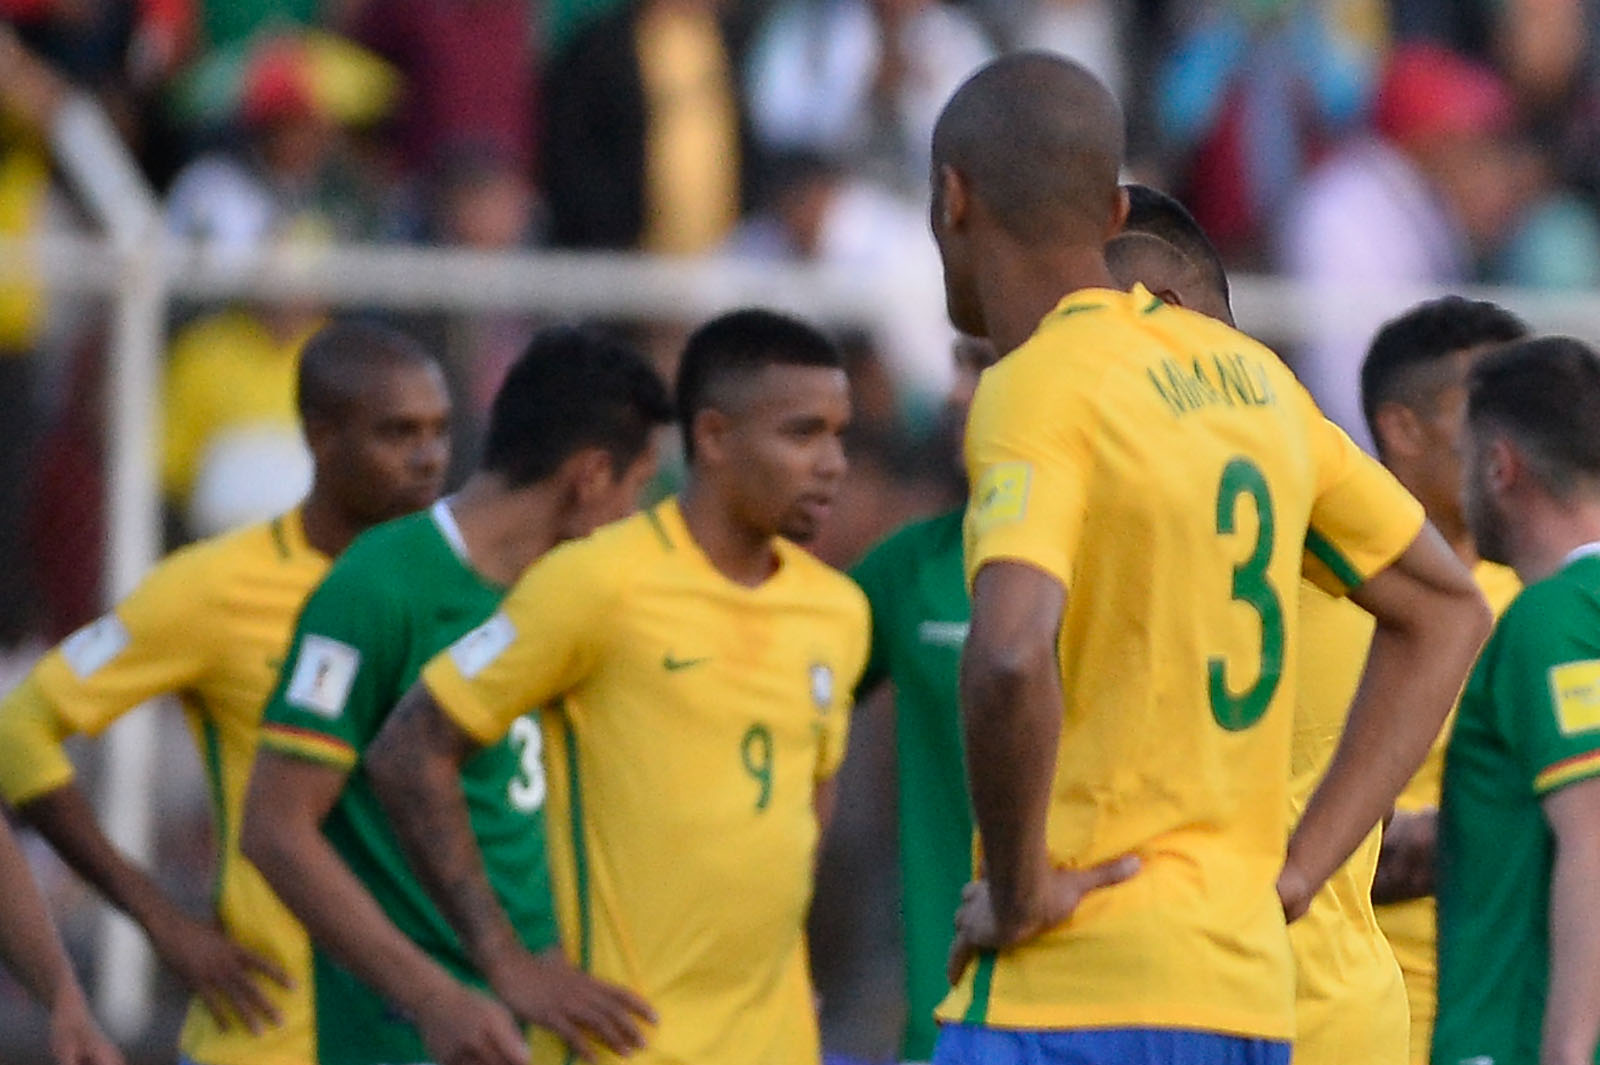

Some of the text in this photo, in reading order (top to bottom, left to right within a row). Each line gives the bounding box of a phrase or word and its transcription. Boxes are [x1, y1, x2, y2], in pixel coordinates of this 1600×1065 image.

[1207, 456, 1284, 732] 3
[508, 714, 546, 813] 3
[741, 722, 772, 812] 9
